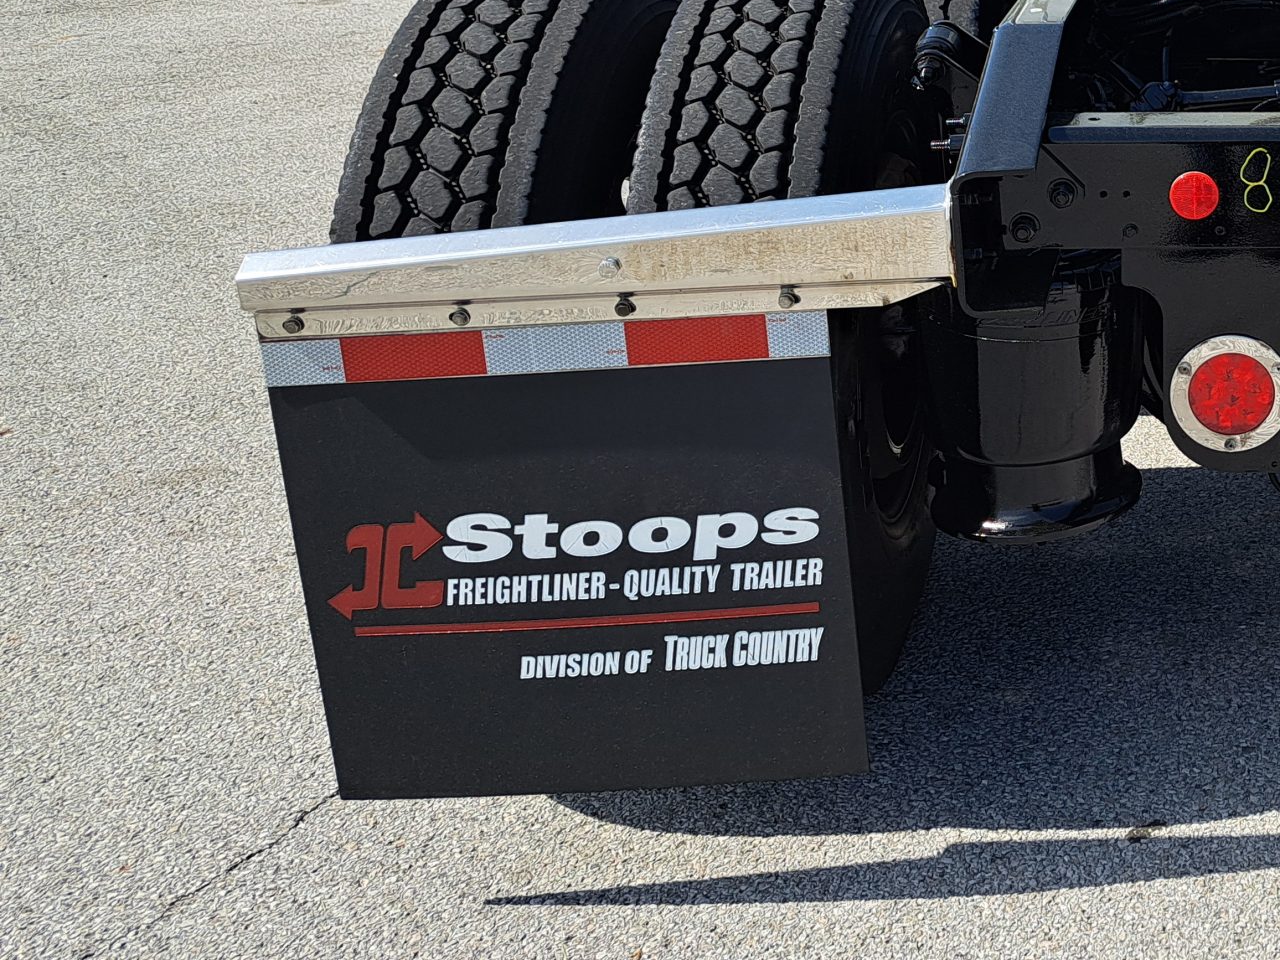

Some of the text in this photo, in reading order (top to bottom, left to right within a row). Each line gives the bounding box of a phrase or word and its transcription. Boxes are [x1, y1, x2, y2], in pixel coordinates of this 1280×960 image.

[442, 507, 821, 563] Stoops
[730, 557, 823, 592] TRAILER
[520, 627, 825, 680] DIVISION OF TRUCK COUNTRY
